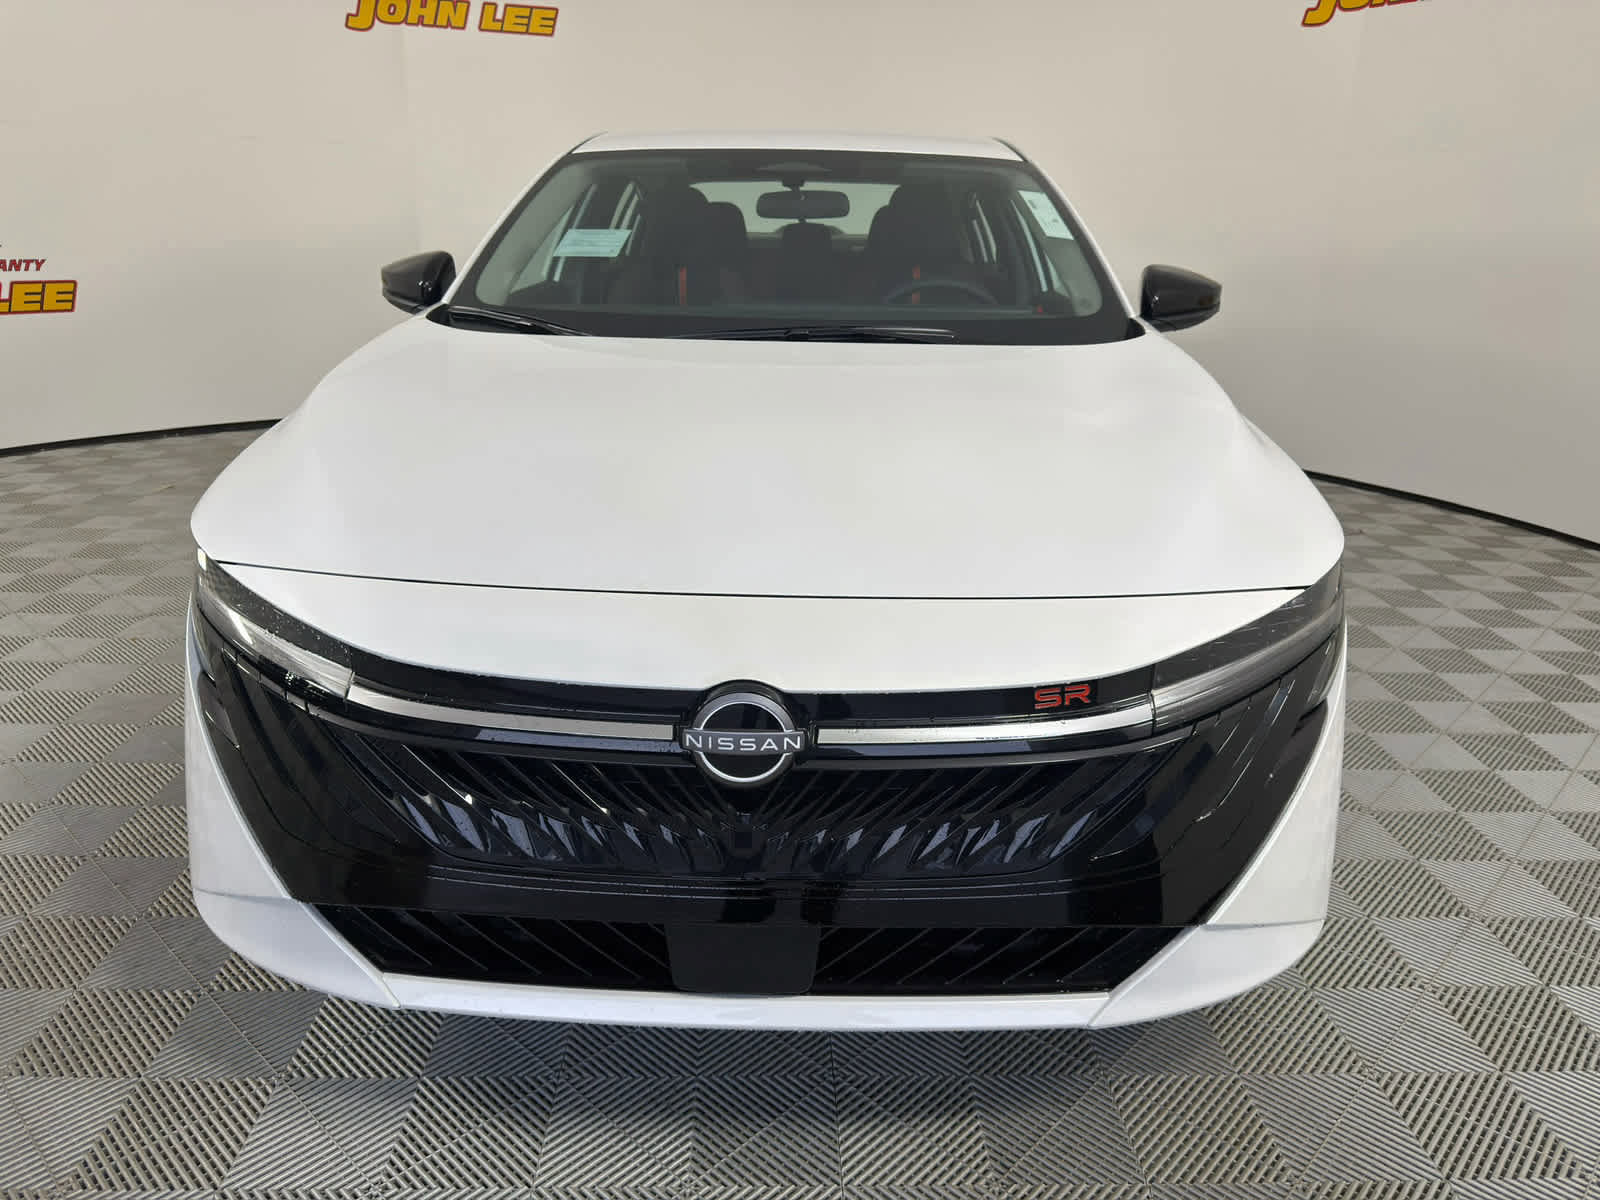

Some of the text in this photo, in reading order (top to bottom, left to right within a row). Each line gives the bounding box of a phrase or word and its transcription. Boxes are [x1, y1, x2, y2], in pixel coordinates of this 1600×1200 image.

[345, 0, 558, 37] JOHN LEE
[1034, 684, 1091, 709] SR
[685, 733, 801, 751] NISSAN
